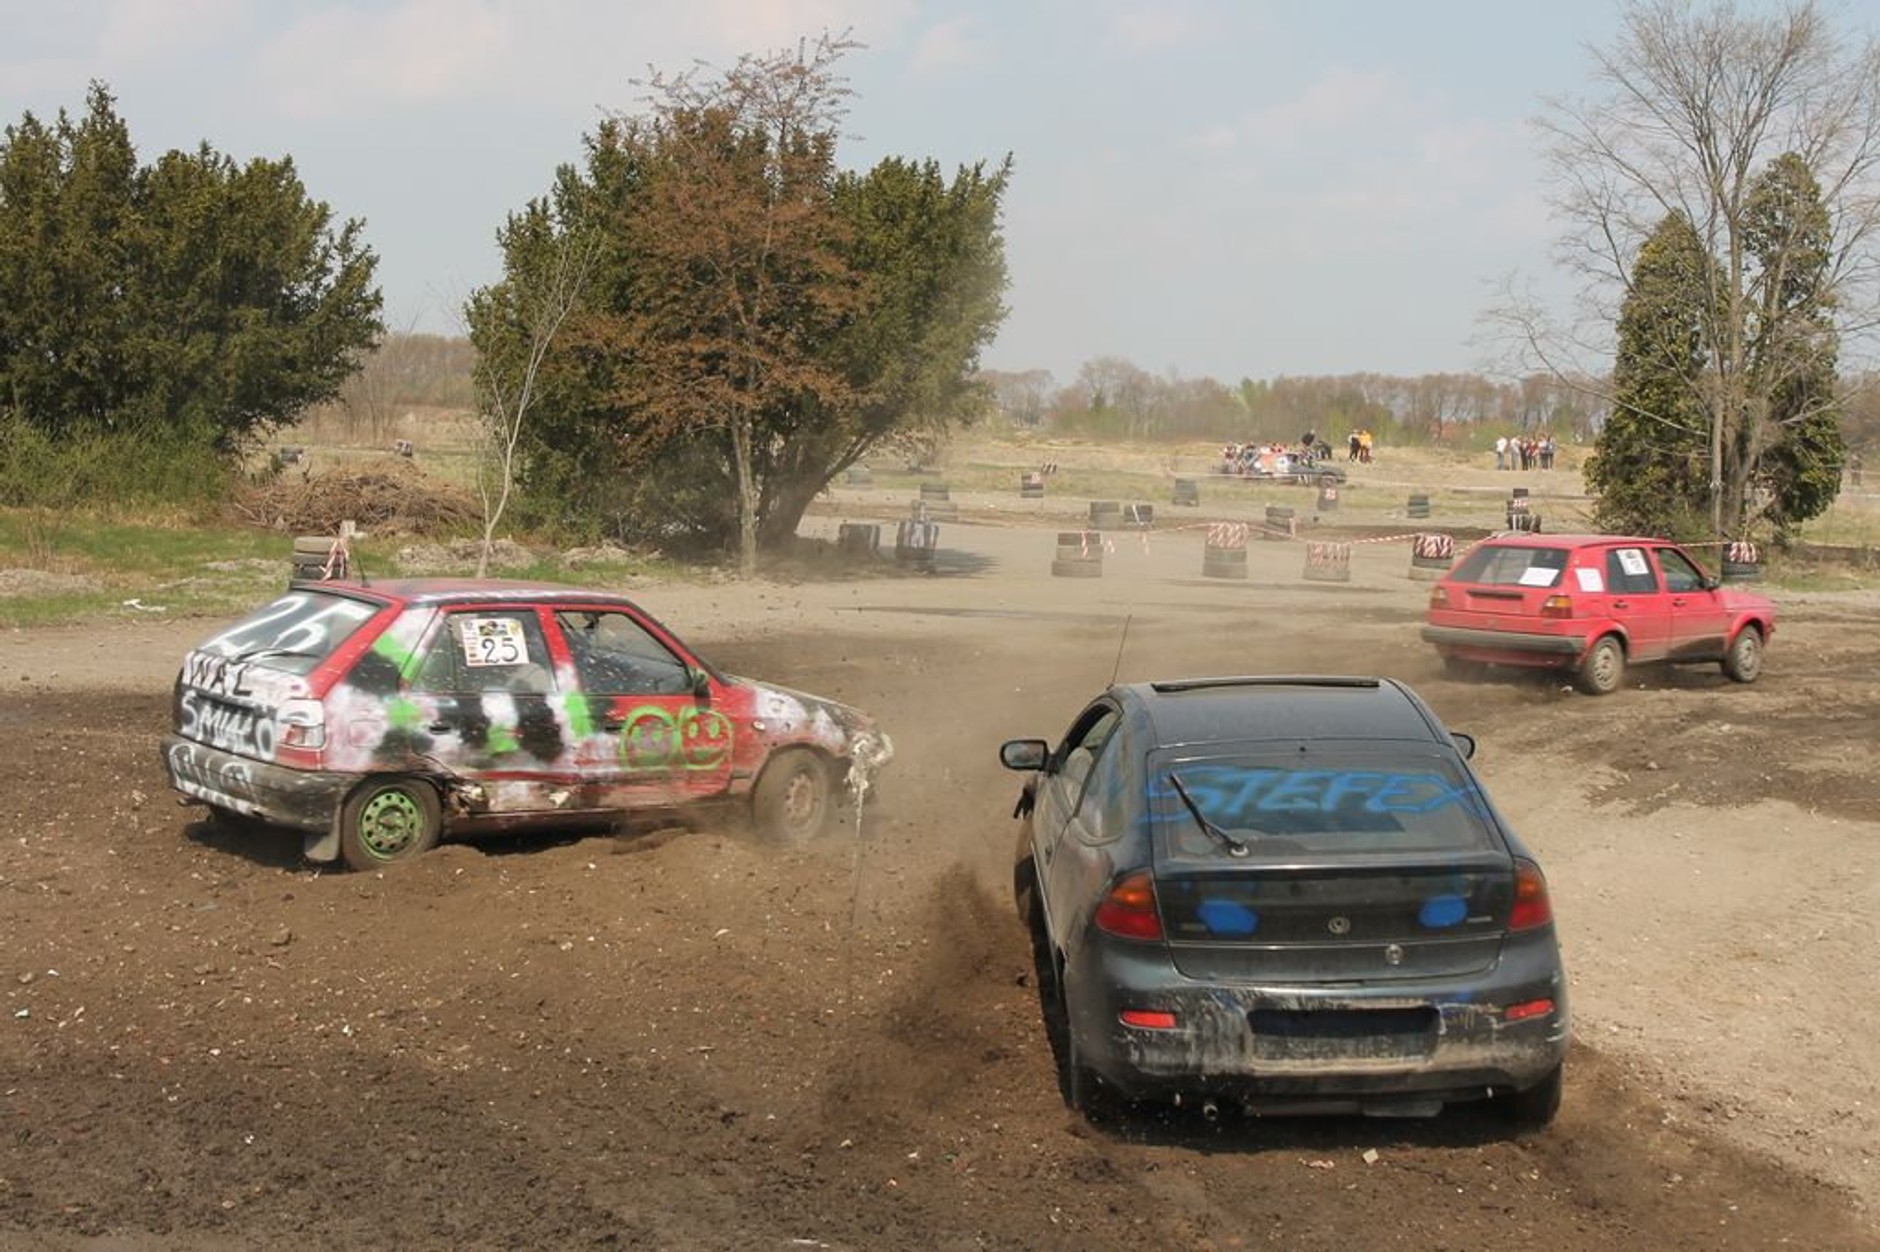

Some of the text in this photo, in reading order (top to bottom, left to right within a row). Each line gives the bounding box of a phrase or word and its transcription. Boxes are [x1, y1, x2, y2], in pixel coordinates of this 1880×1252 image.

[199, 595, 372, 660] 25
[481, 637, 519, 663] 25
[1138, 765, 1490, 825] STEFEX
